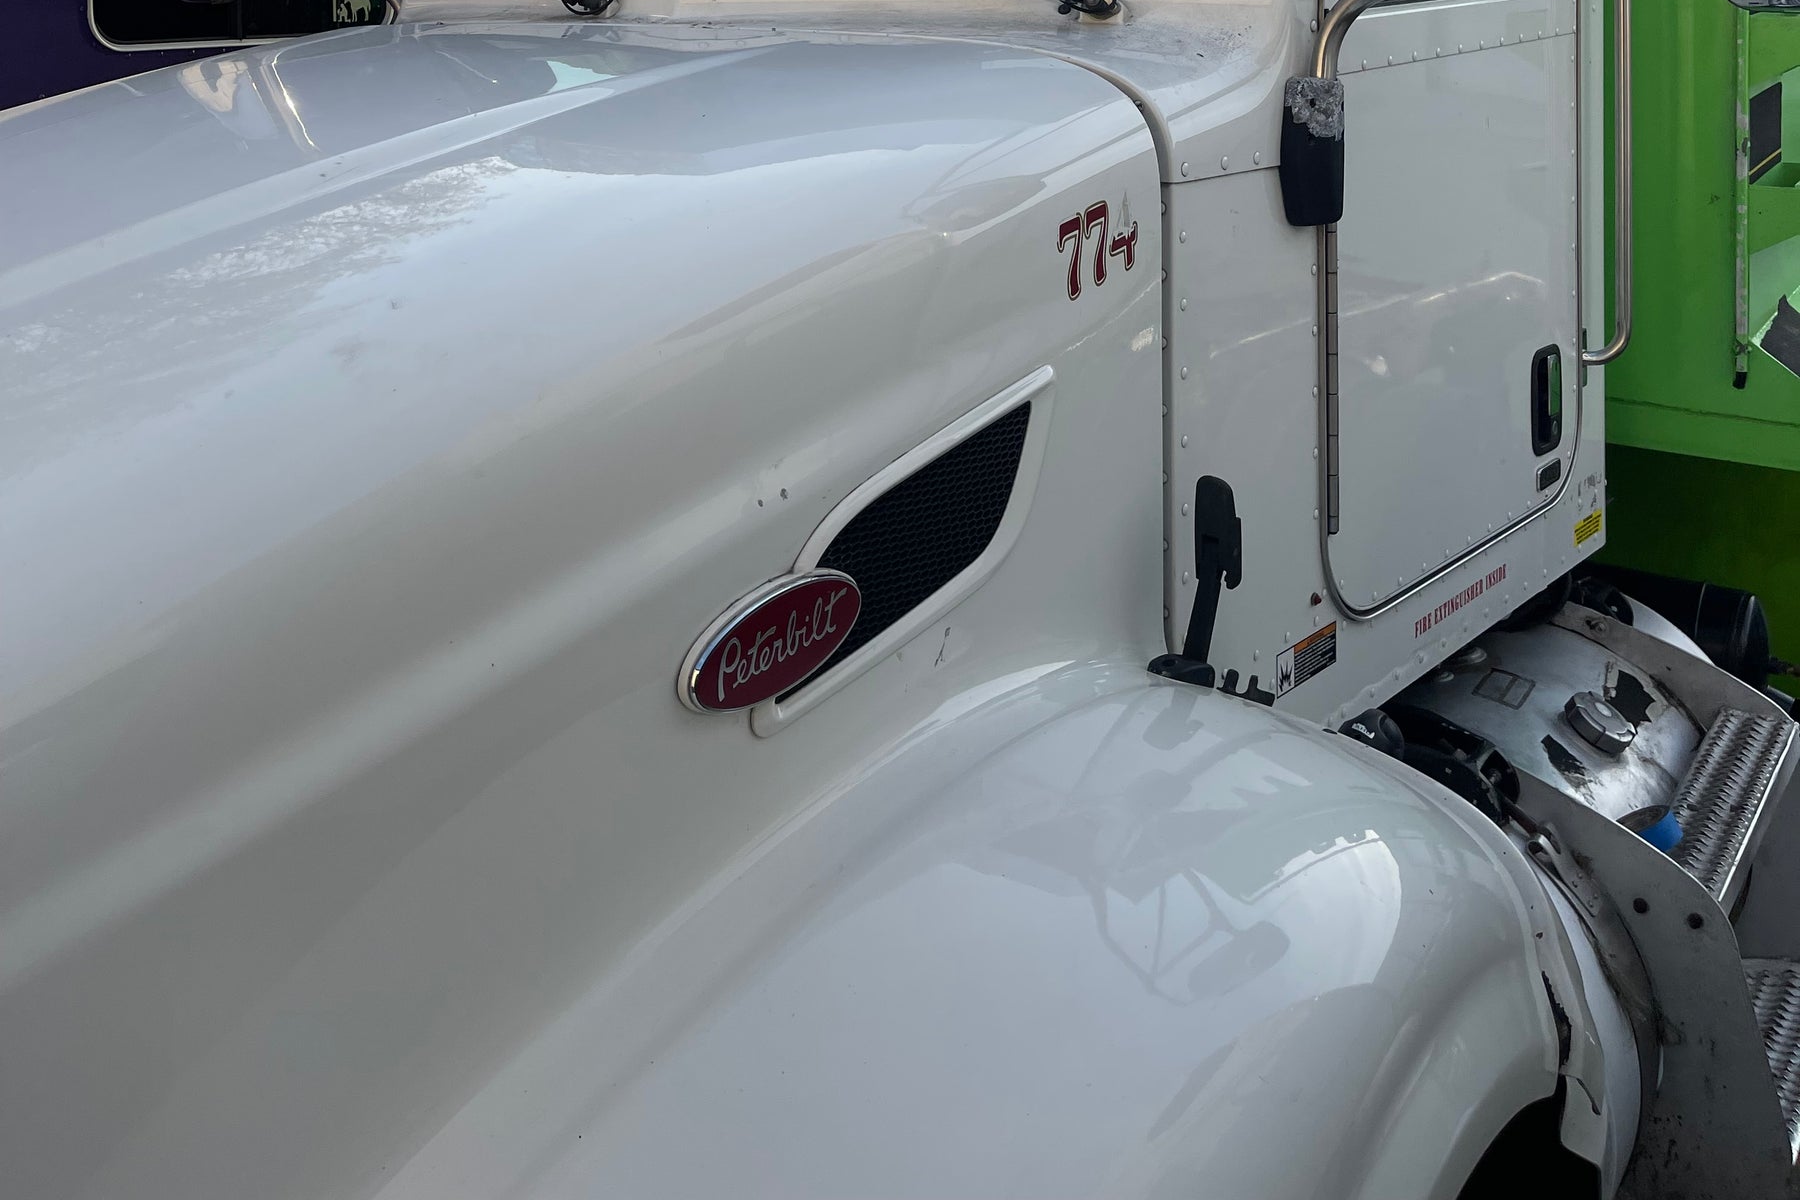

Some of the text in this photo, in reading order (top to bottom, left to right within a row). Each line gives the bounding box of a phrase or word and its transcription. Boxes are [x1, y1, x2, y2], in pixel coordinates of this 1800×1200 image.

[1056, 199, 1139, 302] 774
[716, 586, 849, 704] Peterbilt
[1414, 563, 1507, 639] FIRE EXTINGUISHER INSIDE
